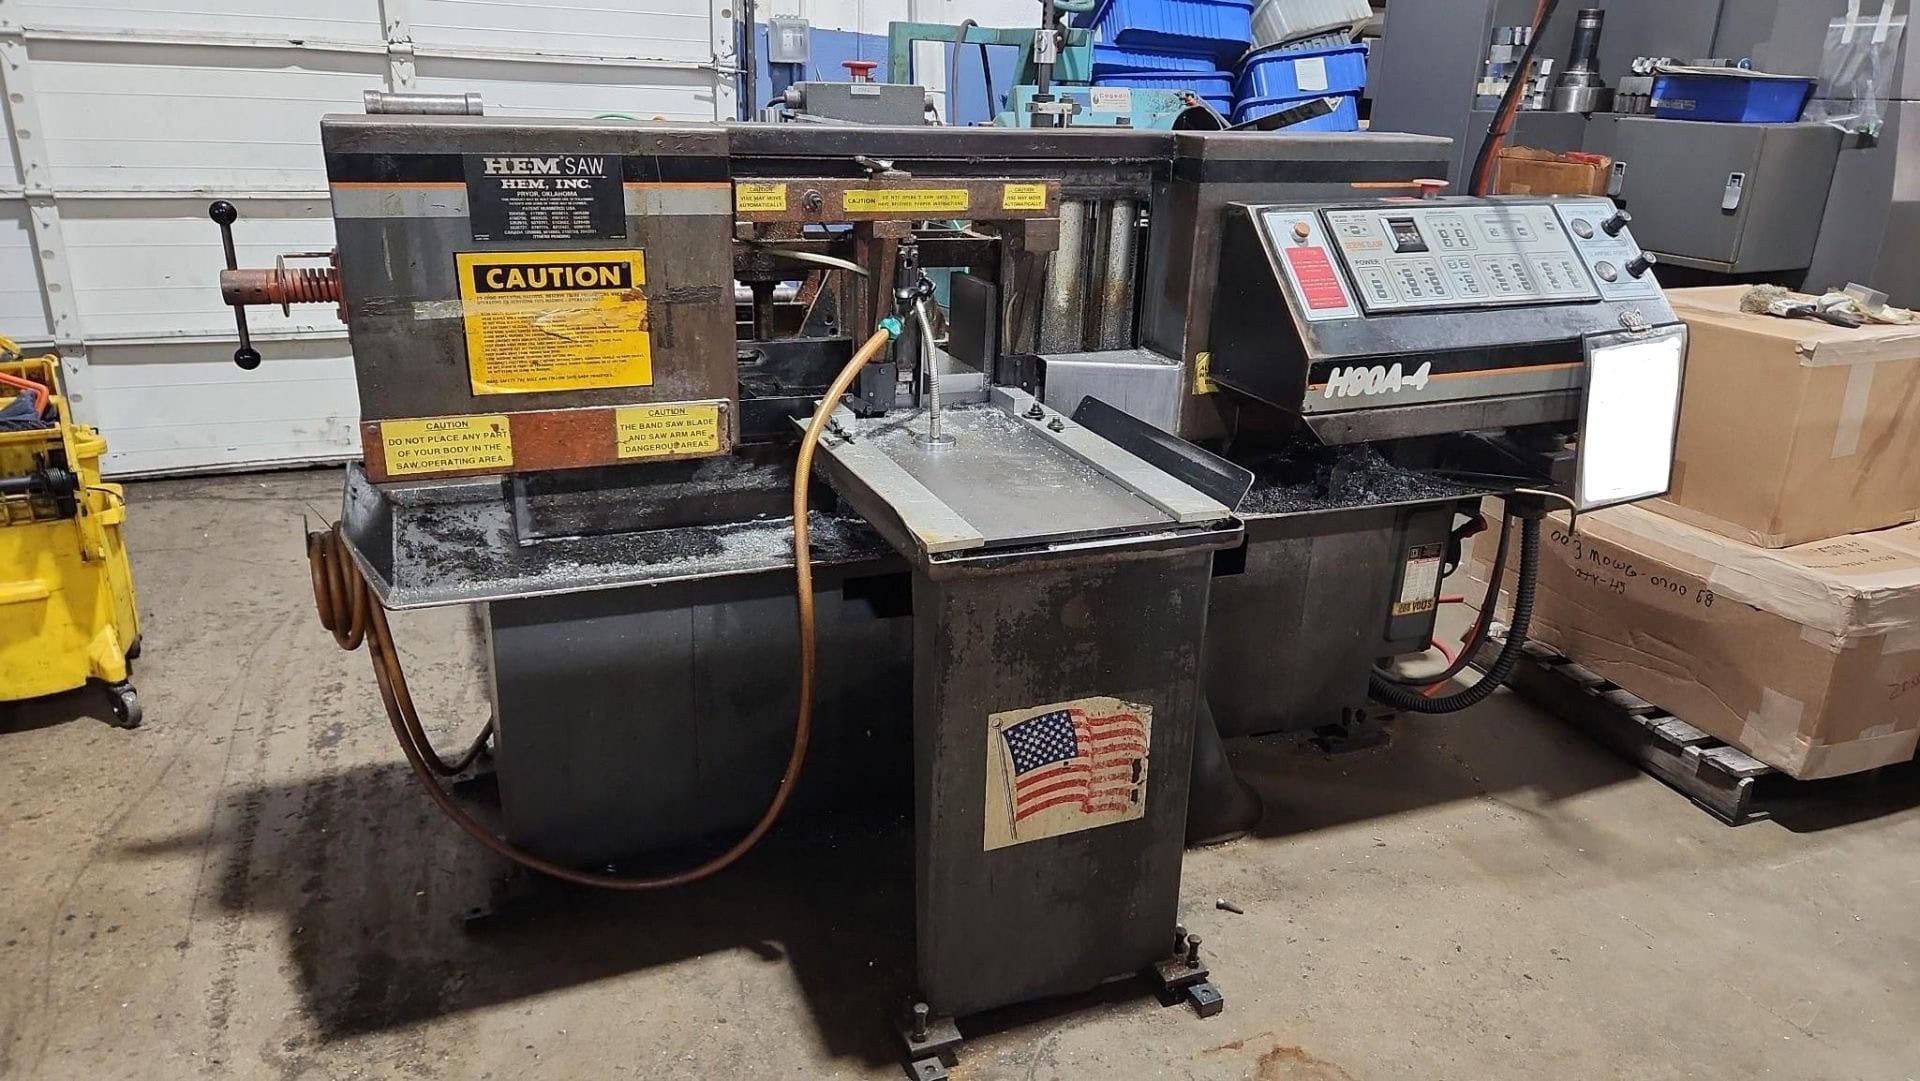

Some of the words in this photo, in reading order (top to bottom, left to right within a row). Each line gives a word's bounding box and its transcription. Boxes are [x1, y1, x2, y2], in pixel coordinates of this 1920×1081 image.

[483, 157, 561, 175] HEM
[565, 157, 604, 175] SAW
[501, 179, 549, 190] HEM,
[555, 179, 592, 189] INC.
[486, 265, 621, 289] CAUTION
[1324, 361, 1431, 398] H90A-4
[648, 407, 686, 417] CAUTION
[426, 421, 469, 431] CAUTION
[620, 423, 636, 431] THE
[639, 421, 663, 430] BAND
[665, 420, 684, 428] SAW
[686, 418, 714, 427] BLADE
[388, 438, 403, 447] DO
[405, 436, 425, 445] NOT
[427, 434, 459, 443] PLACE
[462, 432, 481, 441] ANY
[483, 430, 507, 439] PART
[629, 433, 647, 441] AND
[648, 432, 668, 440] SAW
[669, 431, 689, 439] ARM
[690, 429, 707, 437] ARE
[397, 449, 410, 458] OF
[414, 447, 441, 457] YOUR
[443, 445, 470, 454] BODY
[472, 444, 482, 452] IN
[483, 443, 502, 451] THE
[625, 441, 680, 453] DANGEROUS
[396, 461, 419, 470] SAW
[421, 458, 476, 468] OPERATING
[478, 455, 506, 464] AREA.
